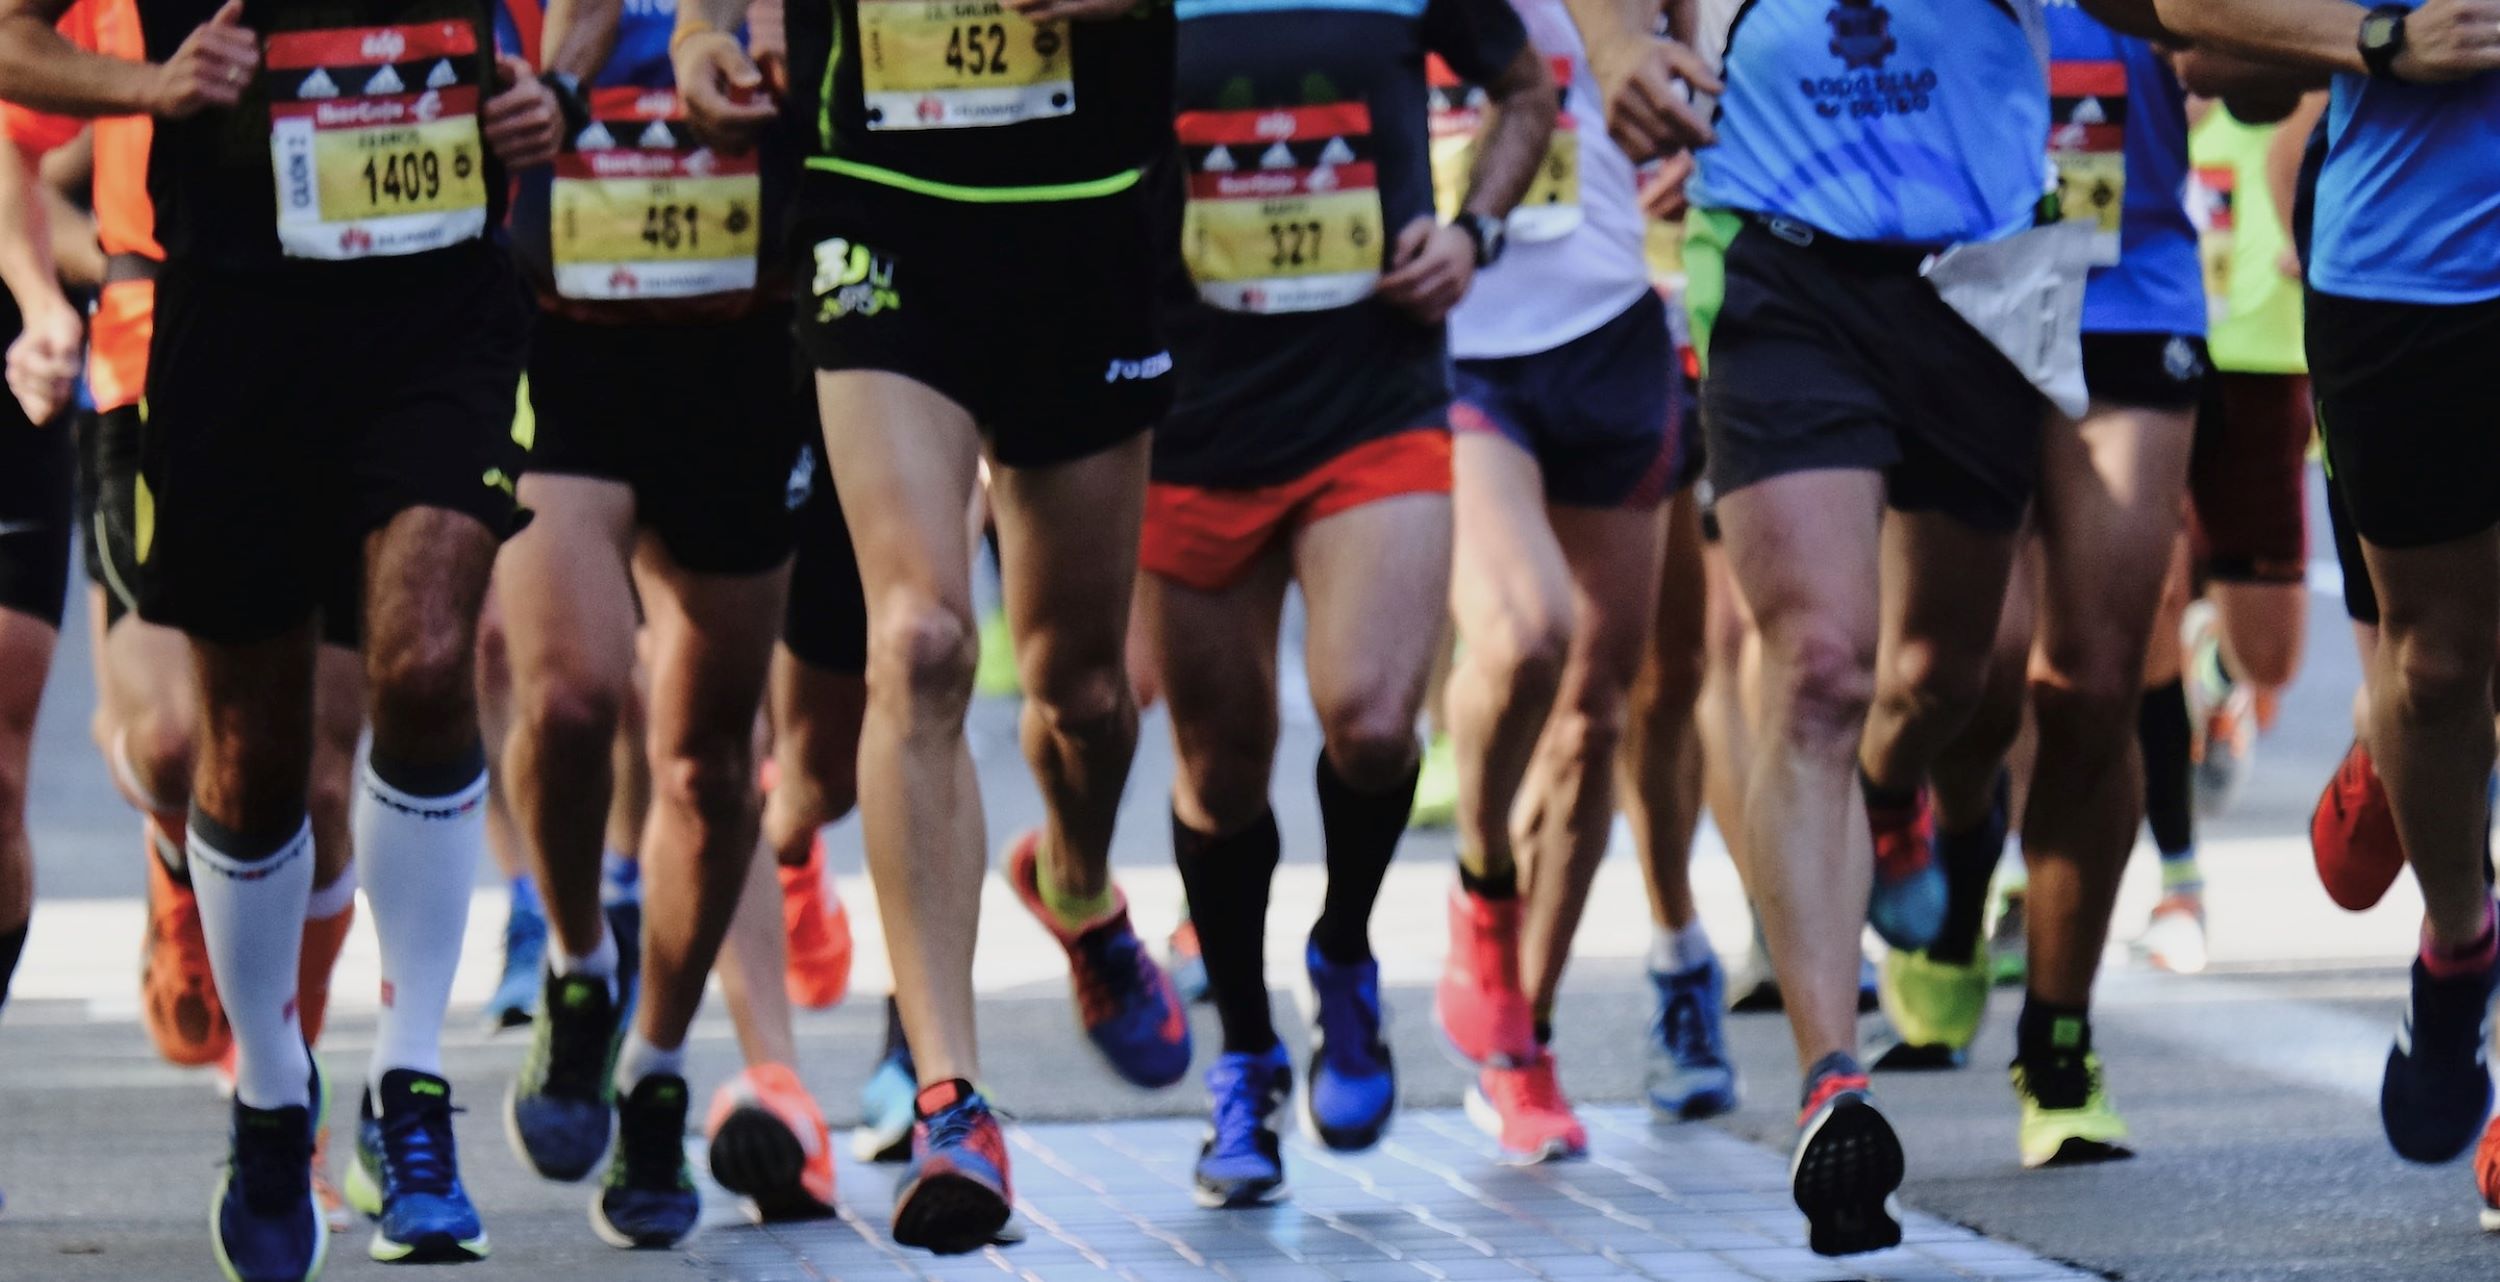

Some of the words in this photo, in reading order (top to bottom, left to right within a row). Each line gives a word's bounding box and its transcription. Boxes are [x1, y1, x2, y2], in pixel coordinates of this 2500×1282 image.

[945, 23, 1008, 75] 452
[362, 150, 440, 206] 1409
[642, 203, 698, 250] 461
[1269, 221, 1321, 268] 327
